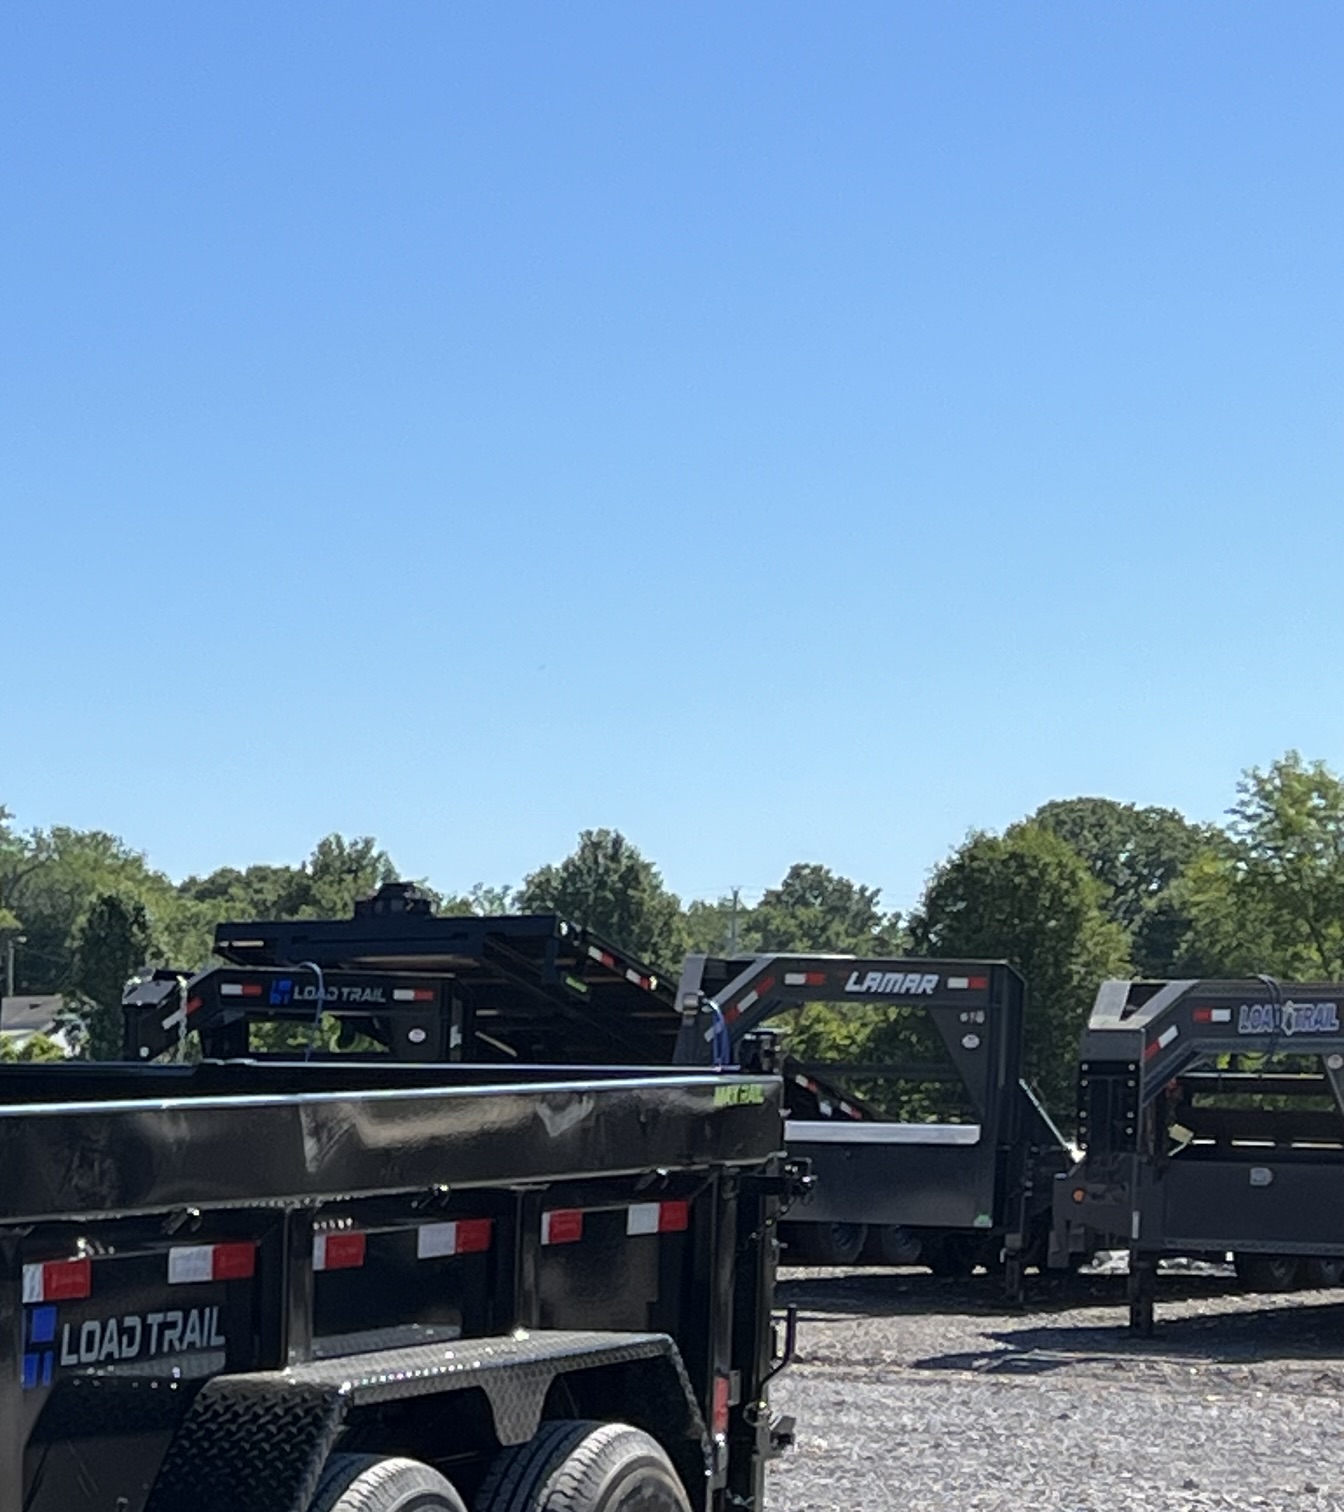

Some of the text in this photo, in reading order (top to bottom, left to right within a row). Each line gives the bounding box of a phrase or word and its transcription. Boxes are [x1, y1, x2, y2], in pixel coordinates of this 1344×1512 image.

[341, 987, 387, 1003] TRAIL
[844, 970, 940, 995] LAMAR
[61, 1306, 226, 1366] LOAD TRAIL
